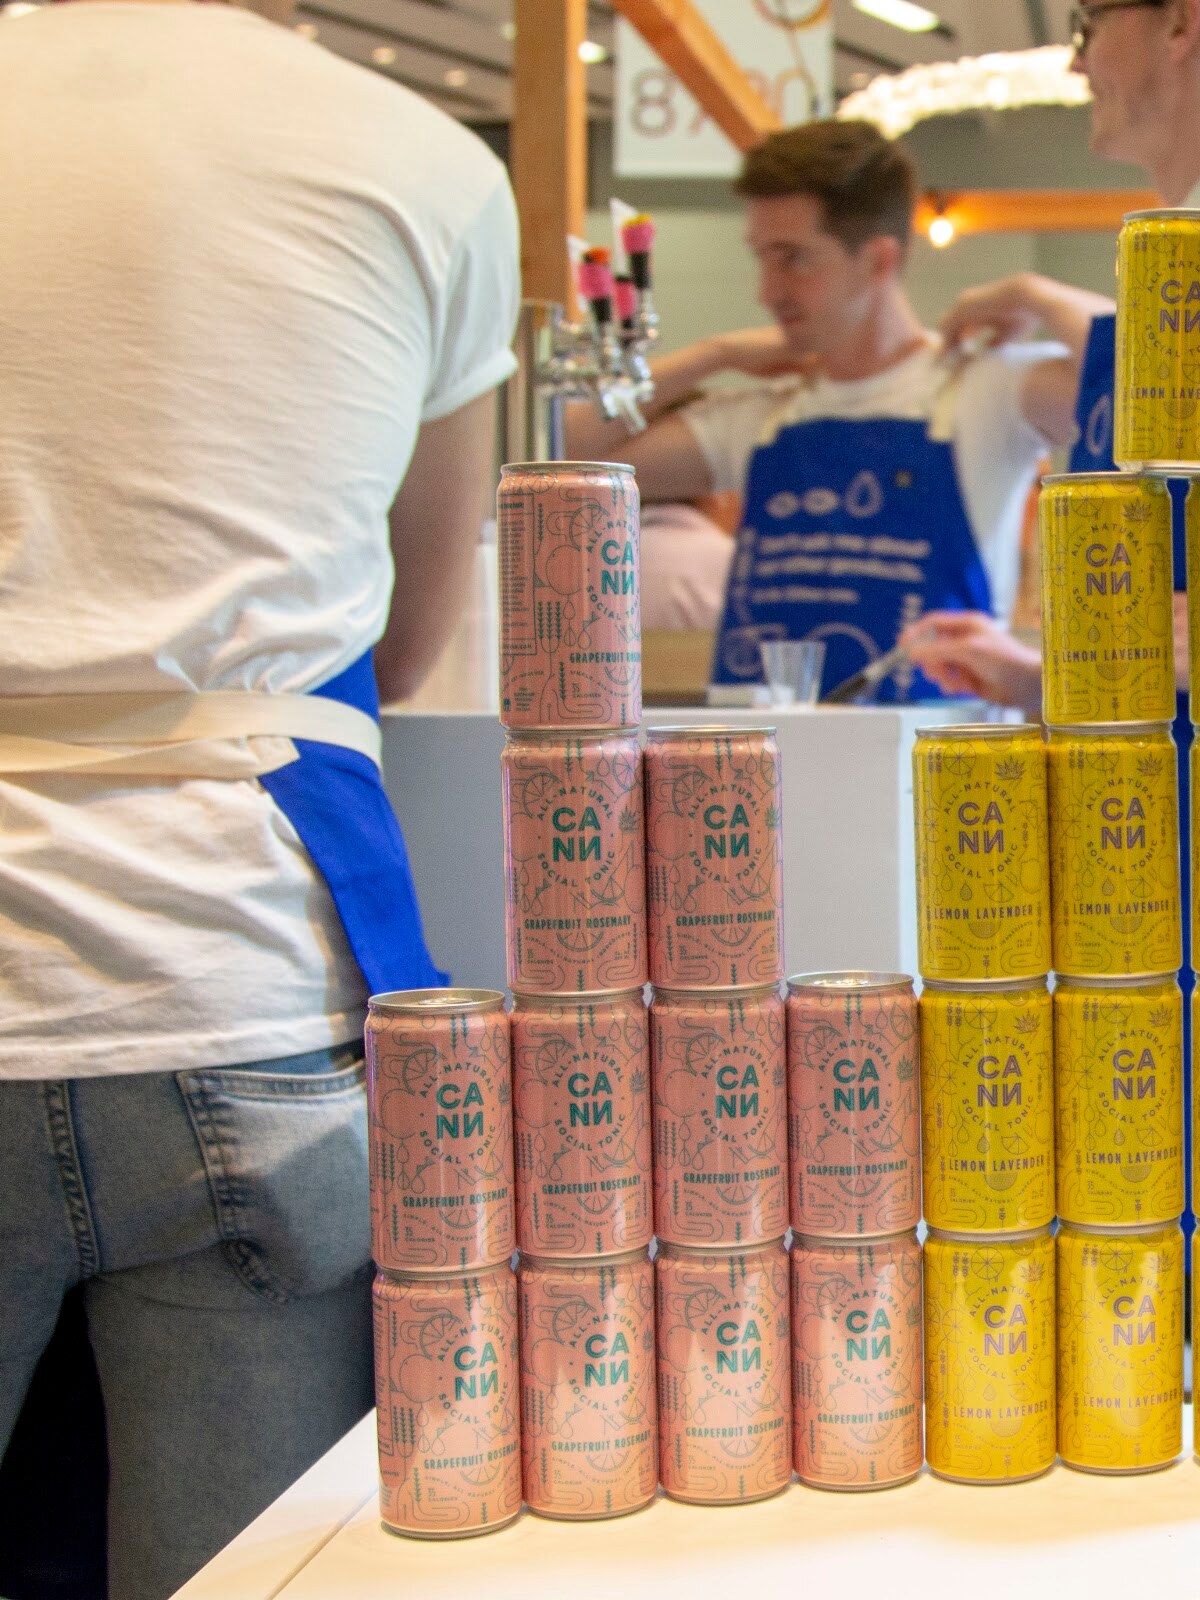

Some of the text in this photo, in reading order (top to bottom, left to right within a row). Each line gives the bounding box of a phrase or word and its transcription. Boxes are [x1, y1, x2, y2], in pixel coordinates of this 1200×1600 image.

[1130, 387, 1165, 400] LEMON
[1086, 543, 1131, 567] CA
[570, 652, 623, 663] GRAPEFRUIT
[1062, 648, 1160, 662] LEMON LAVENDER
[552, 805, 600, 832] CA
[703, 804, 749, 830] CA
[958, 801, 1004, 825] CA
[1101, 798, 1145, 821] CA
[934, 906, 1033, 920] LEMON LAVENDER
[1073, 900, 1170, 915] LEMON LAVENDER
[525, 916, 631, 930] GRAPEFRUIT ROSEMARY
[676, 913, 775, 927] GRAPEFRUIT ROSEMARY
[833, 1058, 879, 1083] CA
[978, 1055, 1022, 1079] CA
[1113, 1048, 1156, 1072] CA
[568, 1071, 612, 1097] CA
[717, 1065, 759, 1090] CA
[436, 1082, 484, 1109] CA
[949, 1156, 1045, 1171] LEMON LAVENDER
[1086, 1147, 1178, 1163] LEMON LAVENDER
[684, 1166, 780, 1183] GRAPEFRUIT ROSEMARY
[806, 1160, 907, 1176] GRAPEFRUIT ROSEMARY
[542, 1175, 641, 1194] GRAPEFRUIT ROSEMARY
[403, 1189, 508, 1207] GRAPEFRUIT ROSEMARY
[984, 1304, 1027, 1327] CA
[1113, 1295, 1156, 1319] CA
[846, 1309, 890, 1333] CA
[717, 1320, 761, 1346] CA
[585, 1332, 629, 1359] CA
[454, 1342, 497, 1371] CA
[954, 1401, 1048, 1418] LEMON LAVENDER
[1084, 1390, 1178, 1408] LEMON LAVENDER
[818, 1404, 914, 1423] GRAPEFRUIT ROSEMARY
[686, 1417, 784, 1438] GRAPEFRUIT ROSEMARY
[552, 1430, 651, 1452] GRAPEFRUIT ROSEMARY
[424, 1453, 483, 1469] GRAPEFRUIT
